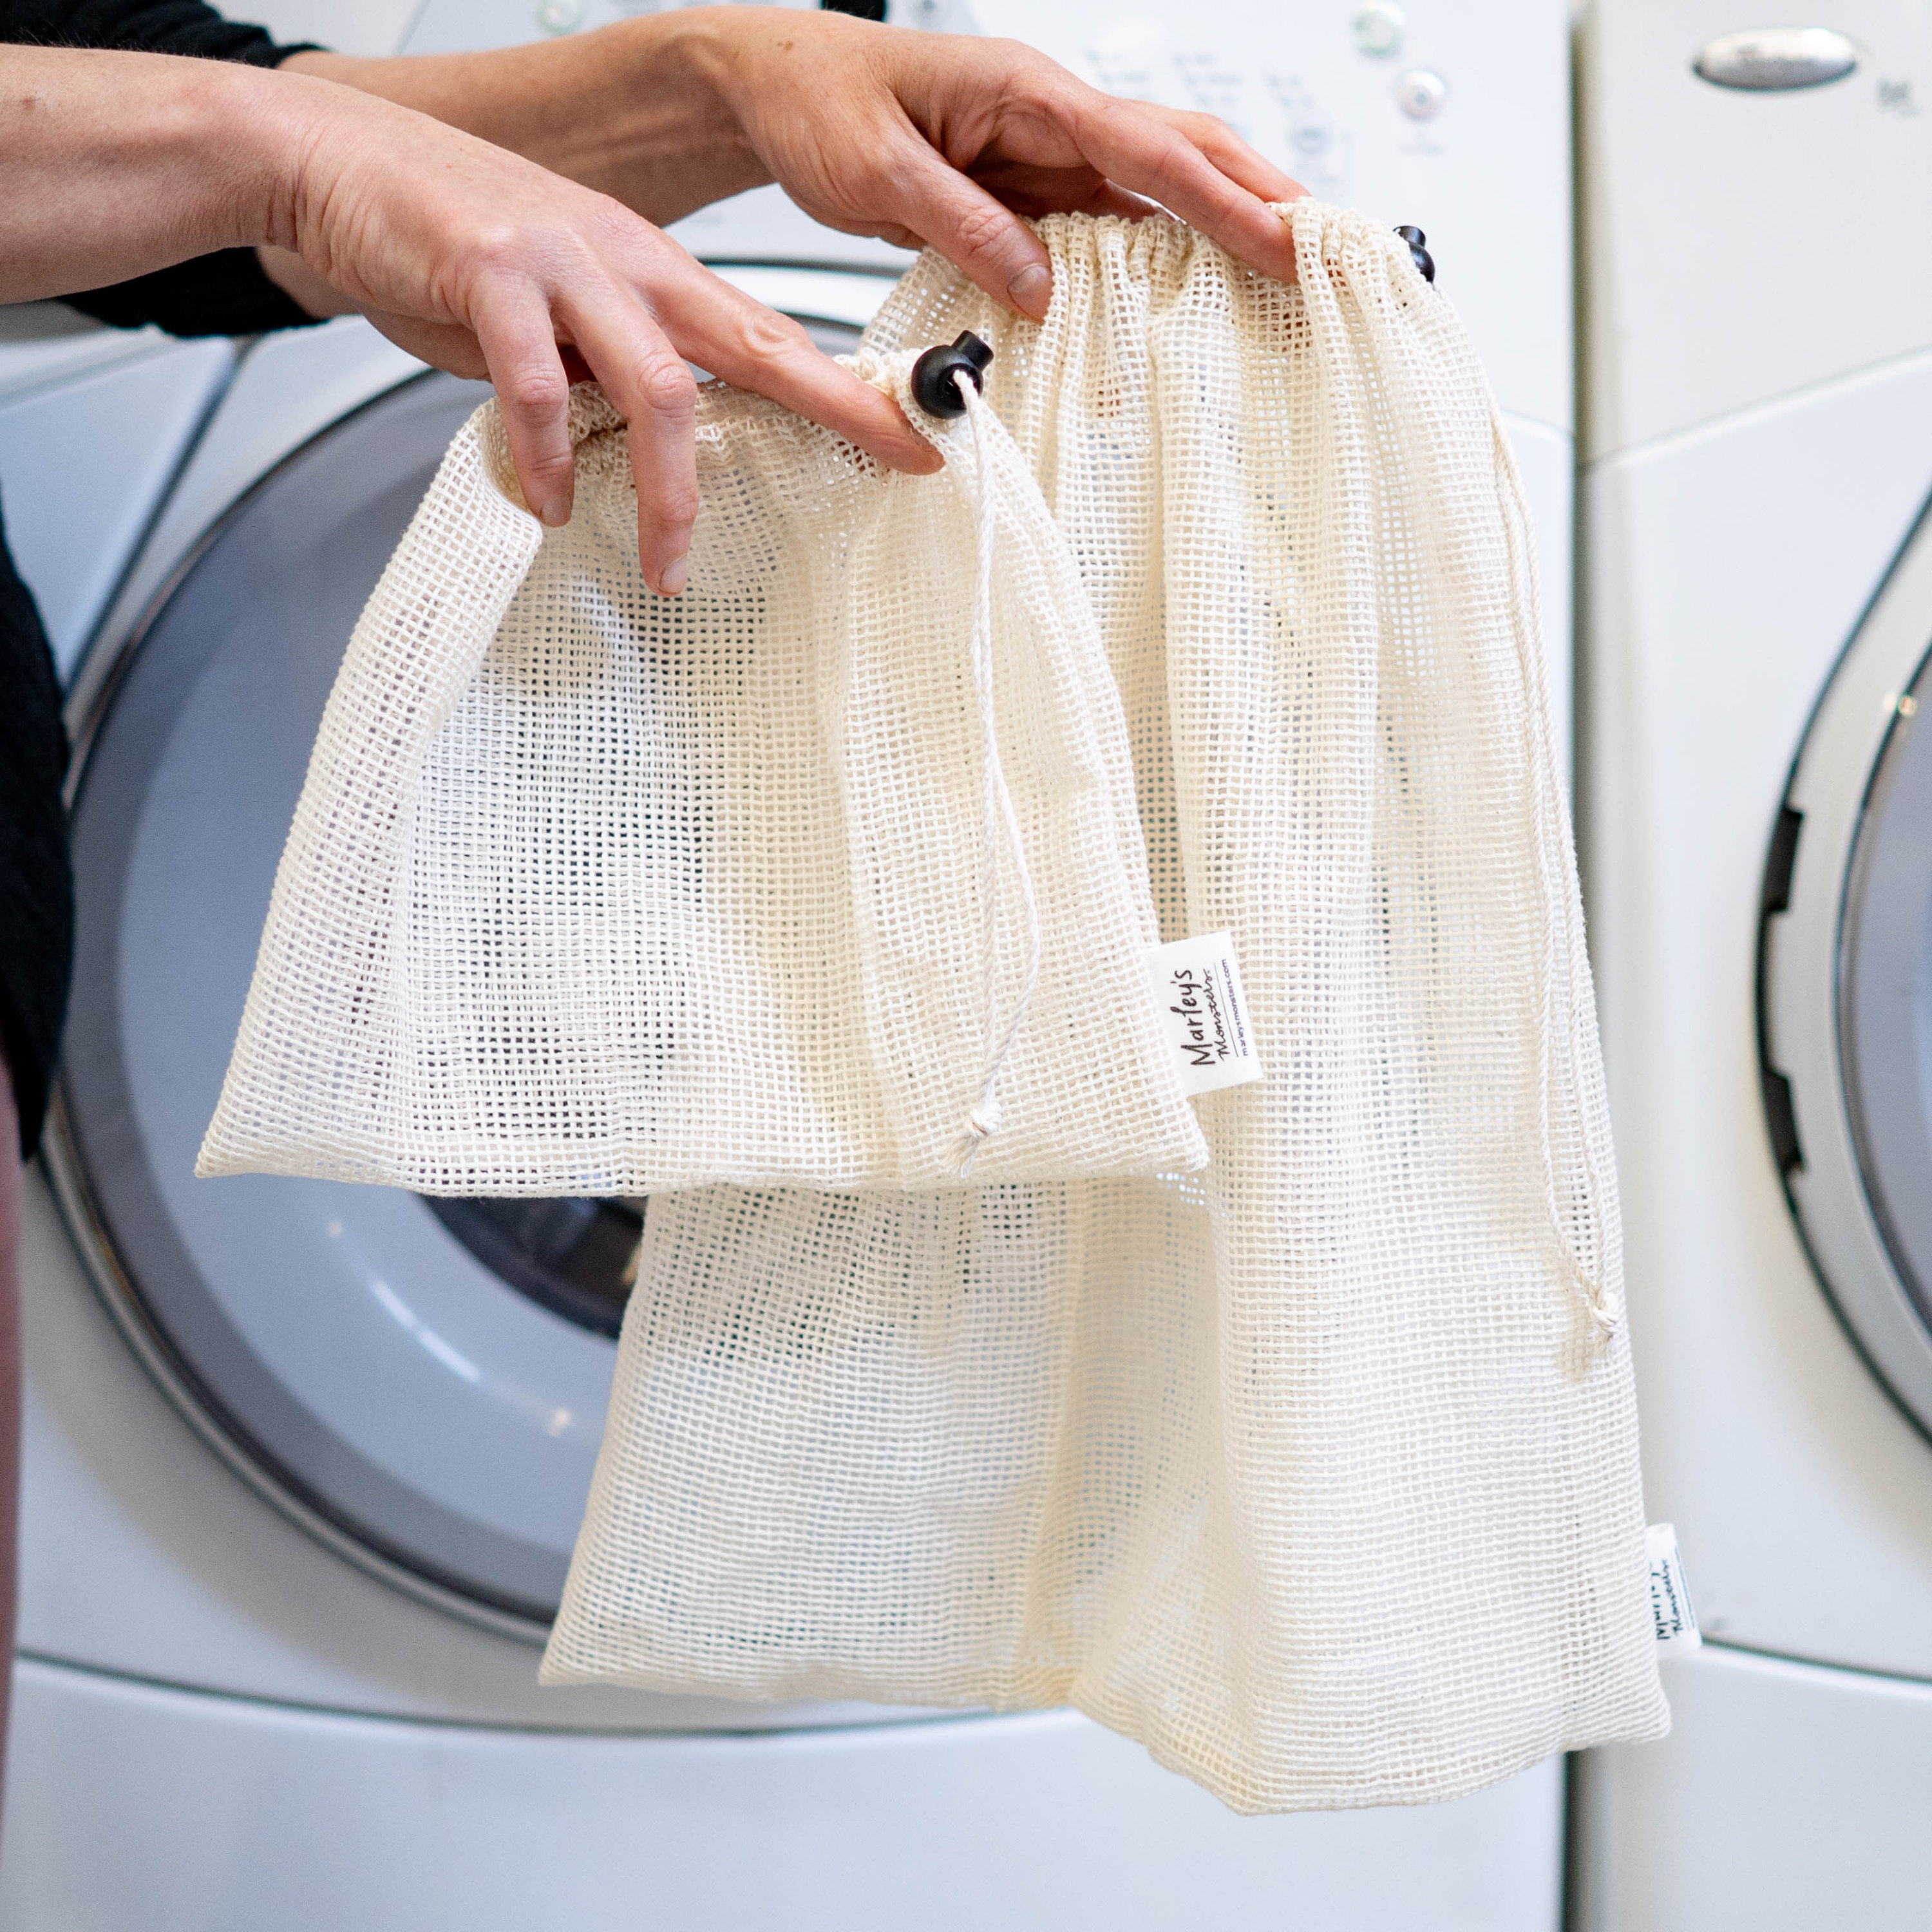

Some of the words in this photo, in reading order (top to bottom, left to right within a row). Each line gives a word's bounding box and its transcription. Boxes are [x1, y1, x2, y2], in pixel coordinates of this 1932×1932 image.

[1170, 969, 1215, 1066] Marley's
[1203, 968, 1230, 1061] Monsters
[1221, 958, 1249, 1057] marleysmonsters.com
